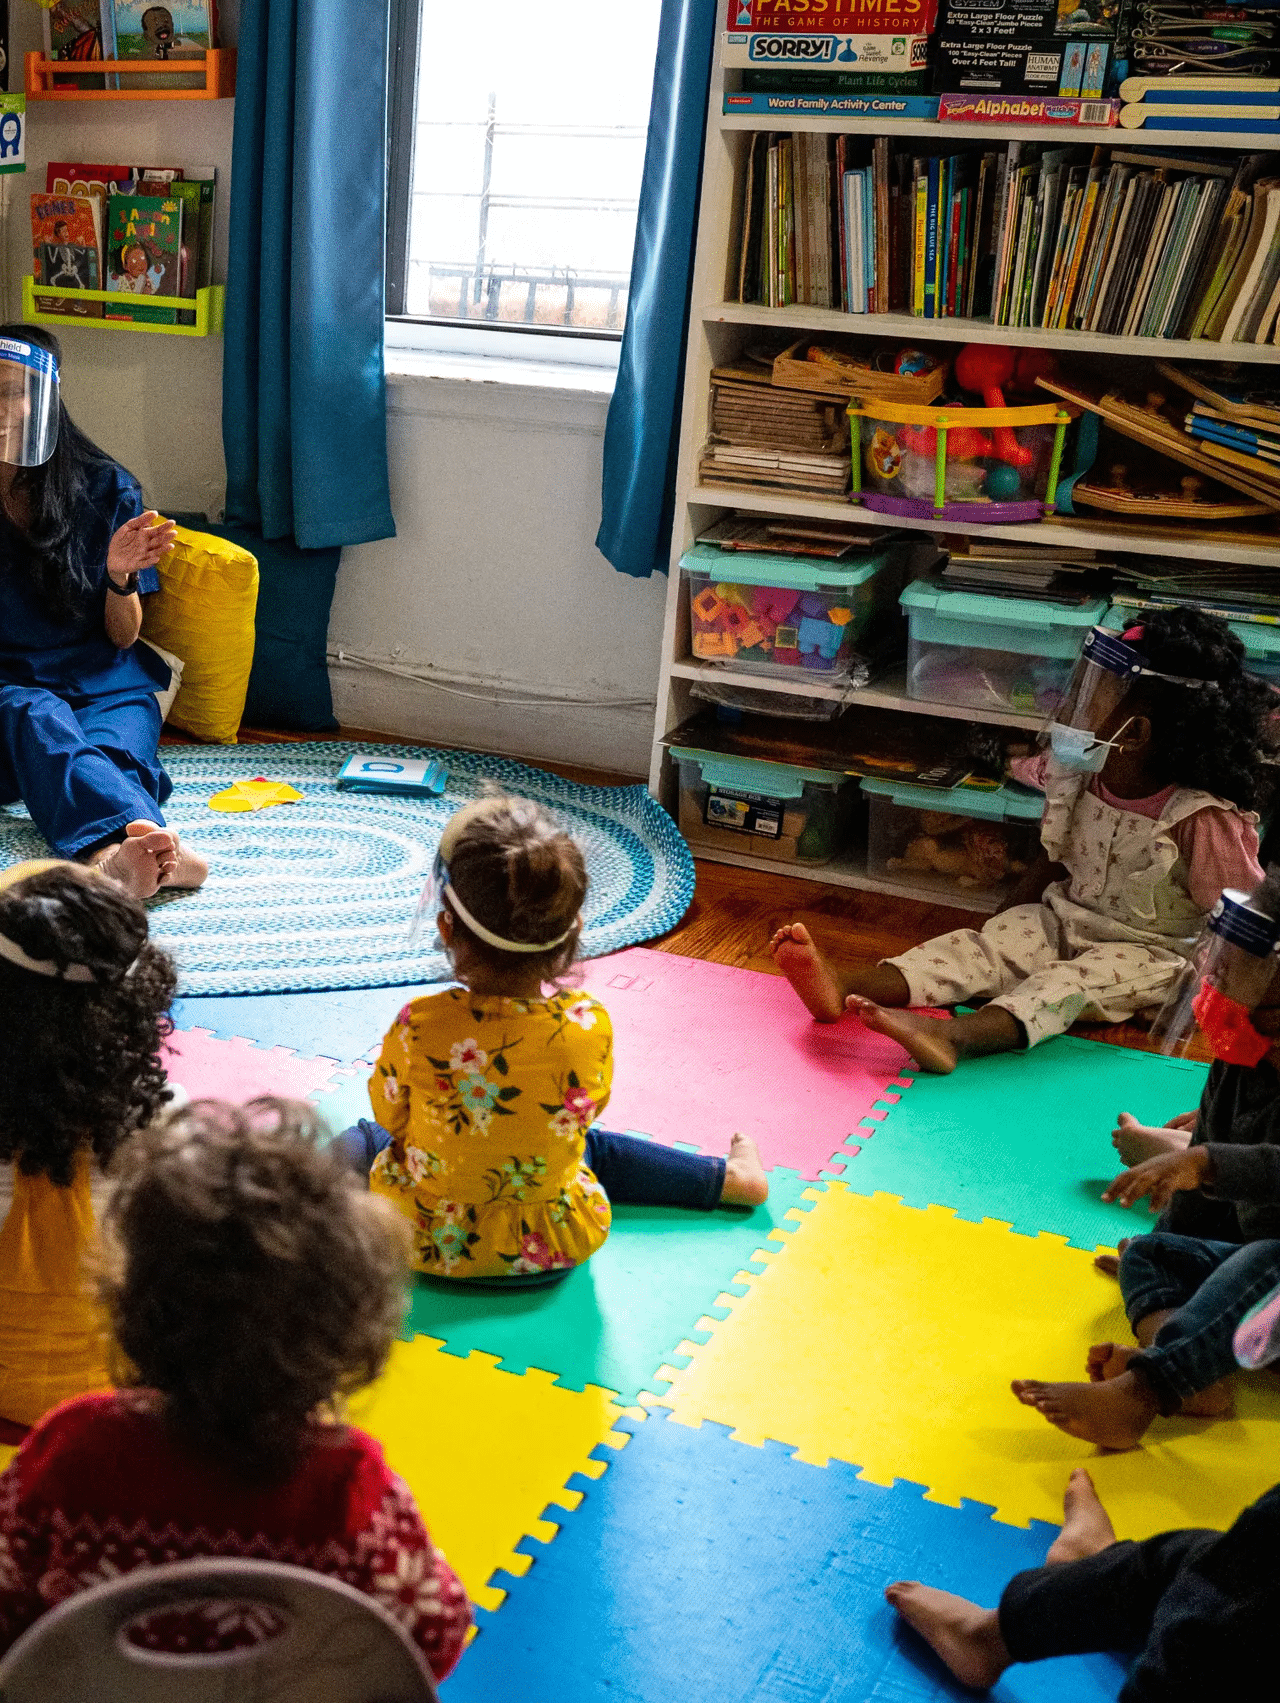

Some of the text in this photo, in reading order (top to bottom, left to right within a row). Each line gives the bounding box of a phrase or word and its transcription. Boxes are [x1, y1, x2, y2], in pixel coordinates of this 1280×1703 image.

[755, 16, 919, 28] THE GAME OF HISTORY
[947, 11, 969, 19] Extra
[970, 12, 993, 20] Large
[1017, 13, 1044, 21] Puzzle
[754, 37, 832, 58] SORRY!
[940, 41, 961, 49] Extra
[963, 42, 985, 50] Large
[1007, 43, 1033, 51] Puzzle
[971, 58, 978, 66] 4
[999, 59, 1017, 67] Tall!
[1028, 56, 1059, 65] HUMAN
[1026, 64, 1058, 72] ANATOMY
[838, 75, 919, 88] Plant Life Cycles
[768, 98, 907, 112] Word Family Activity Center
[973, 99, 1046, 116] Alphabet
[929, 203, 937, 218] THE
[928, 231, 936, 248] BLUE
